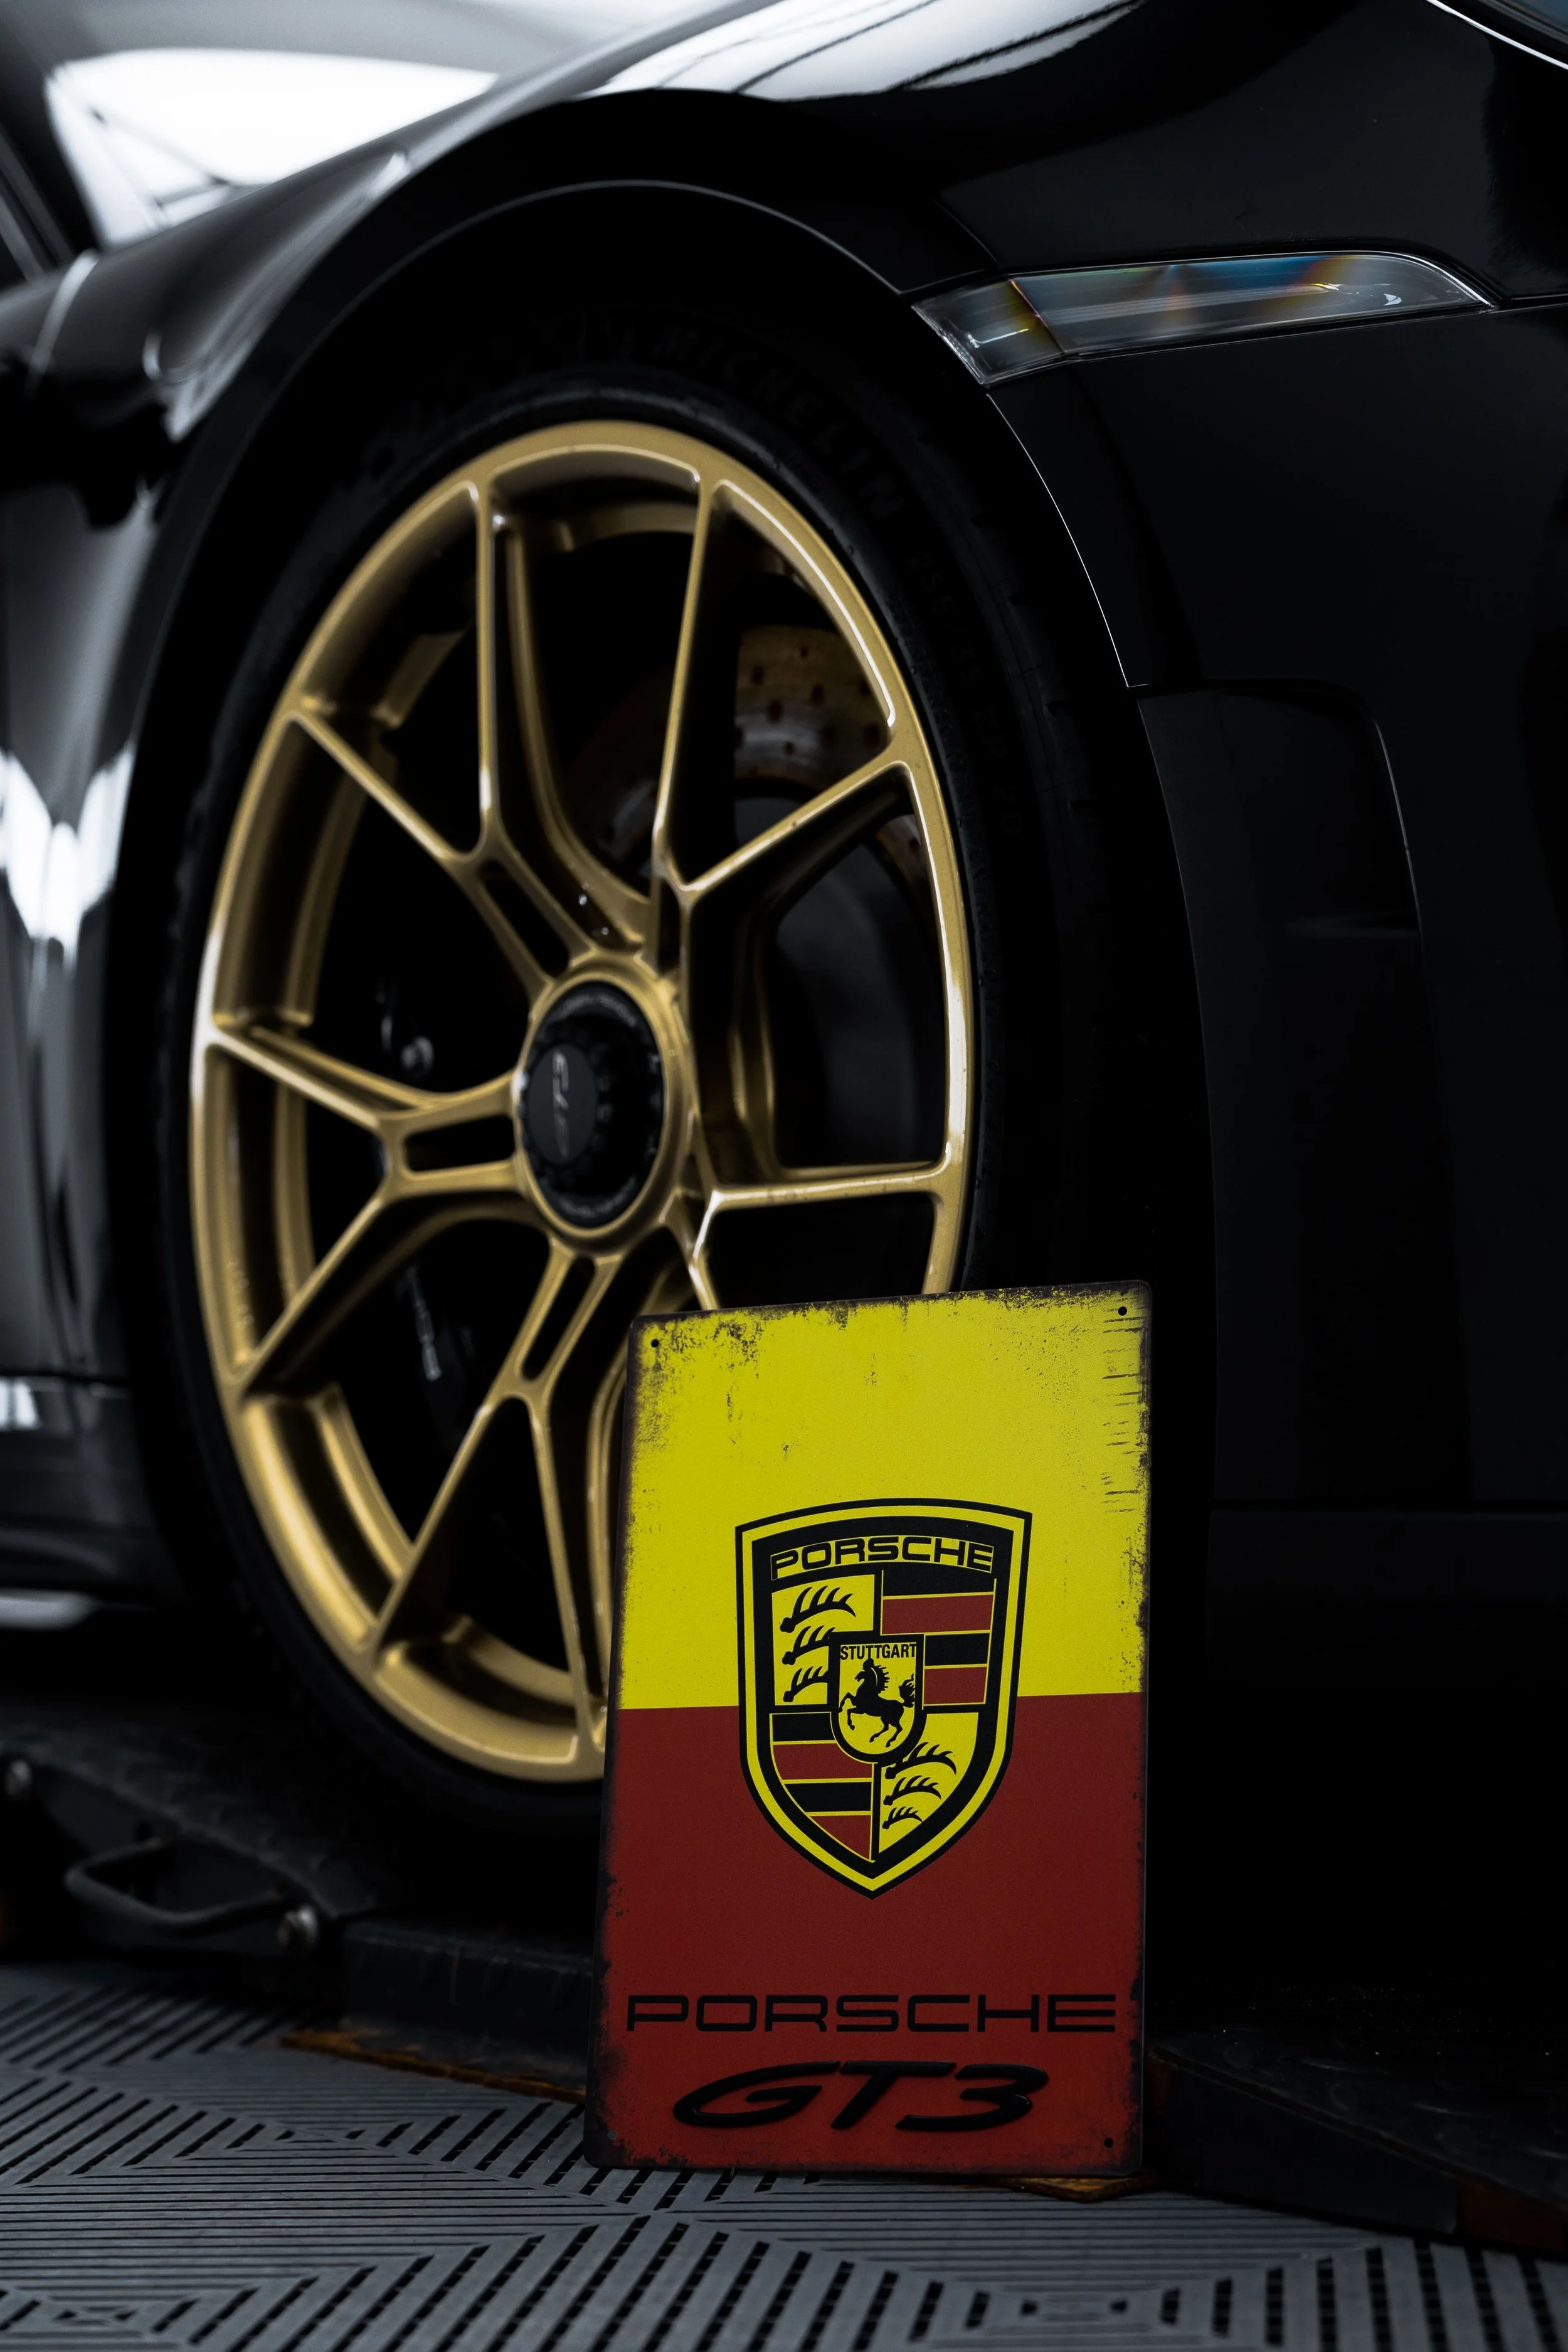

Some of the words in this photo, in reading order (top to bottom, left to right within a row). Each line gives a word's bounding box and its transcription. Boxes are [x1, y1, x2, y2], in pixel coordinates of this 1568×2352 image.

[652, 323, 905, 522] MICHELIN
[771, 1535, 994, 1581] PORSCHE
[840, 1643, 916, 1661] STUTTGART
[627, 1994, 1116, 2032] PORSCHE
[673, 2060, 1048, 2132] GT3
